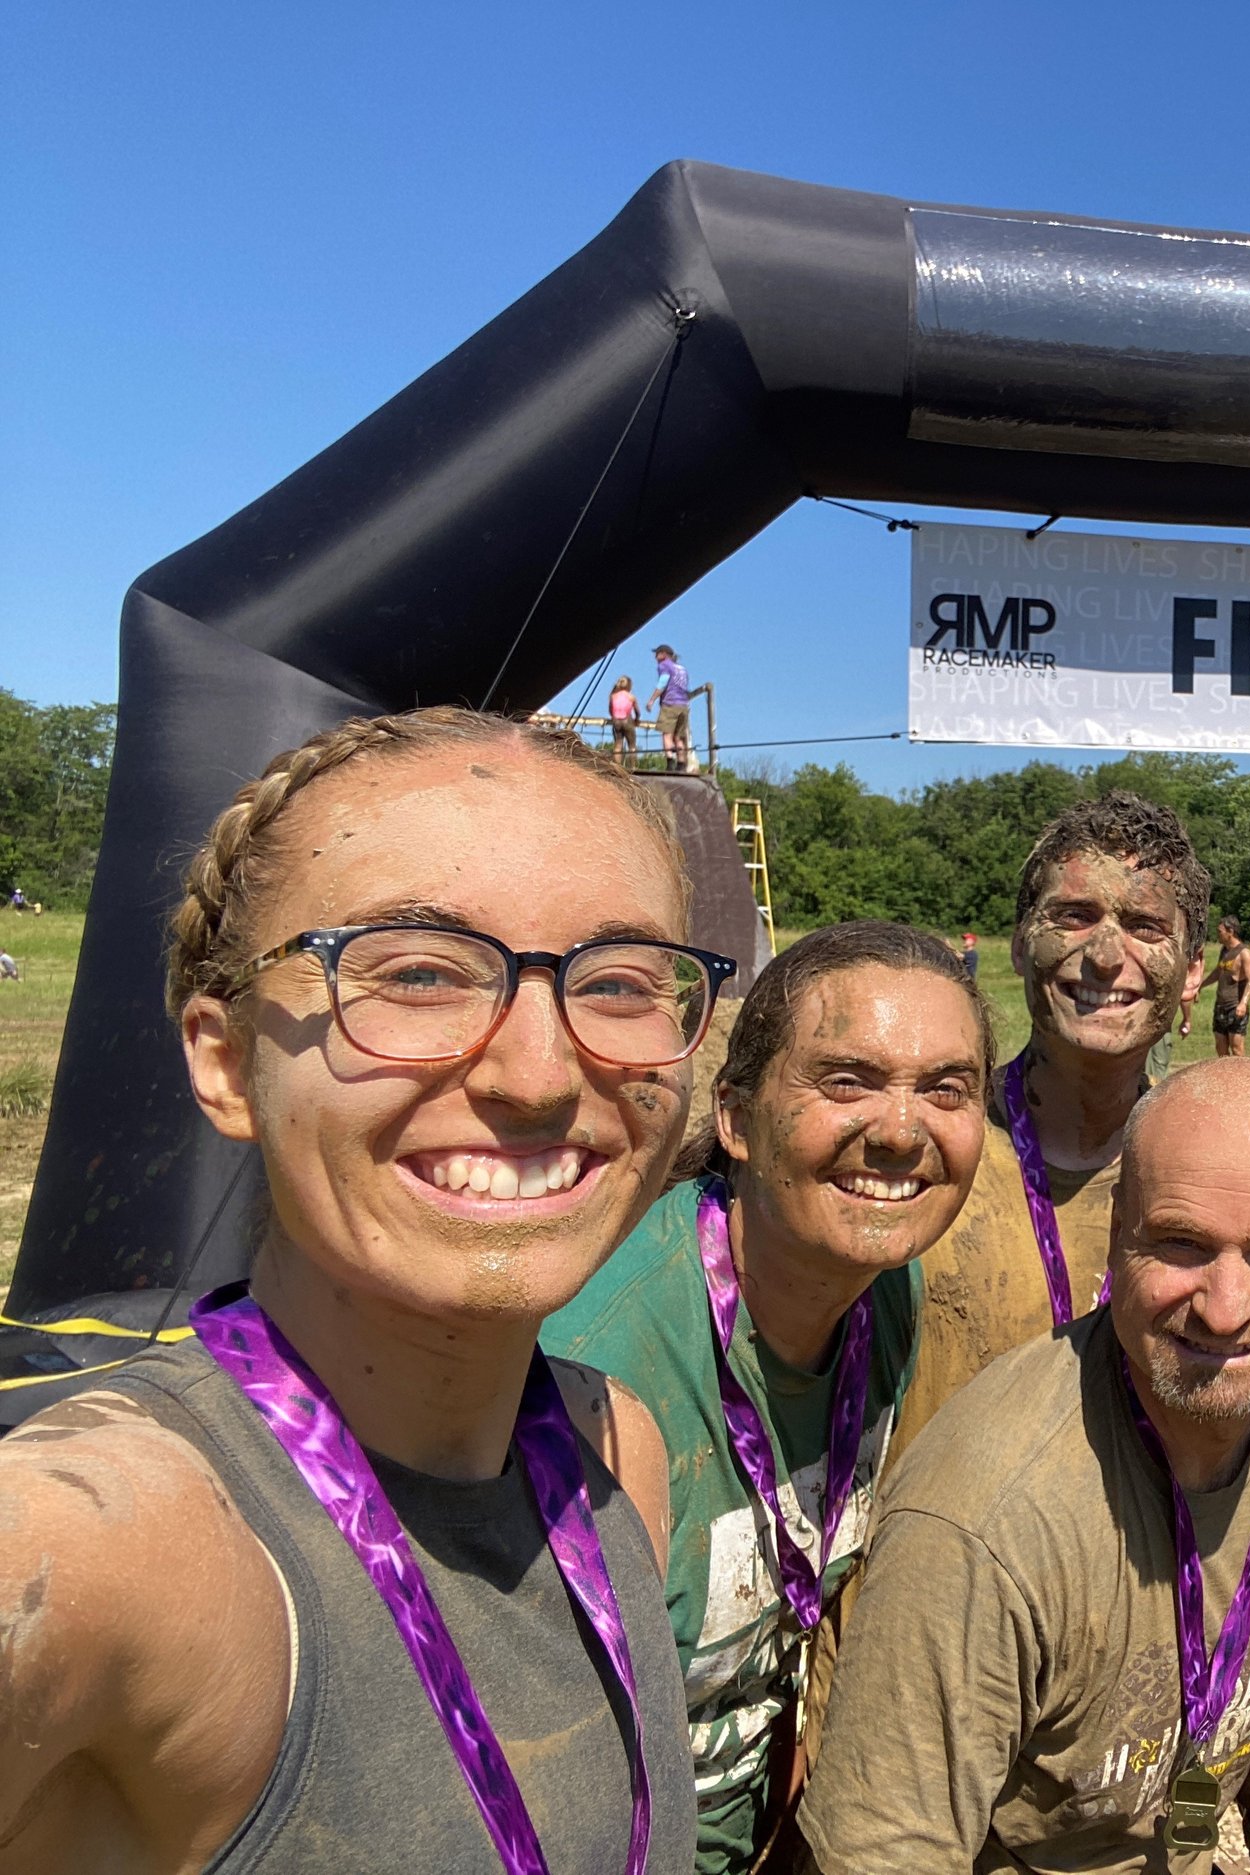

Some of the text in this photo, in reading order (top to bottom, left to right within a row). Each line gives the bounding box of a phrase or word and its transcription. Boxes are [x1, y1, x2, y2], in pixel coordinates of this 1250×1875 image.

[1082, 540, 1179, 578] LIVES
[922, 647, 1057, 672] RACEMAKER
[923, 665, 1059, 680] PRODUCTIONS
[910, 671, 1078, 708] SHAPING
